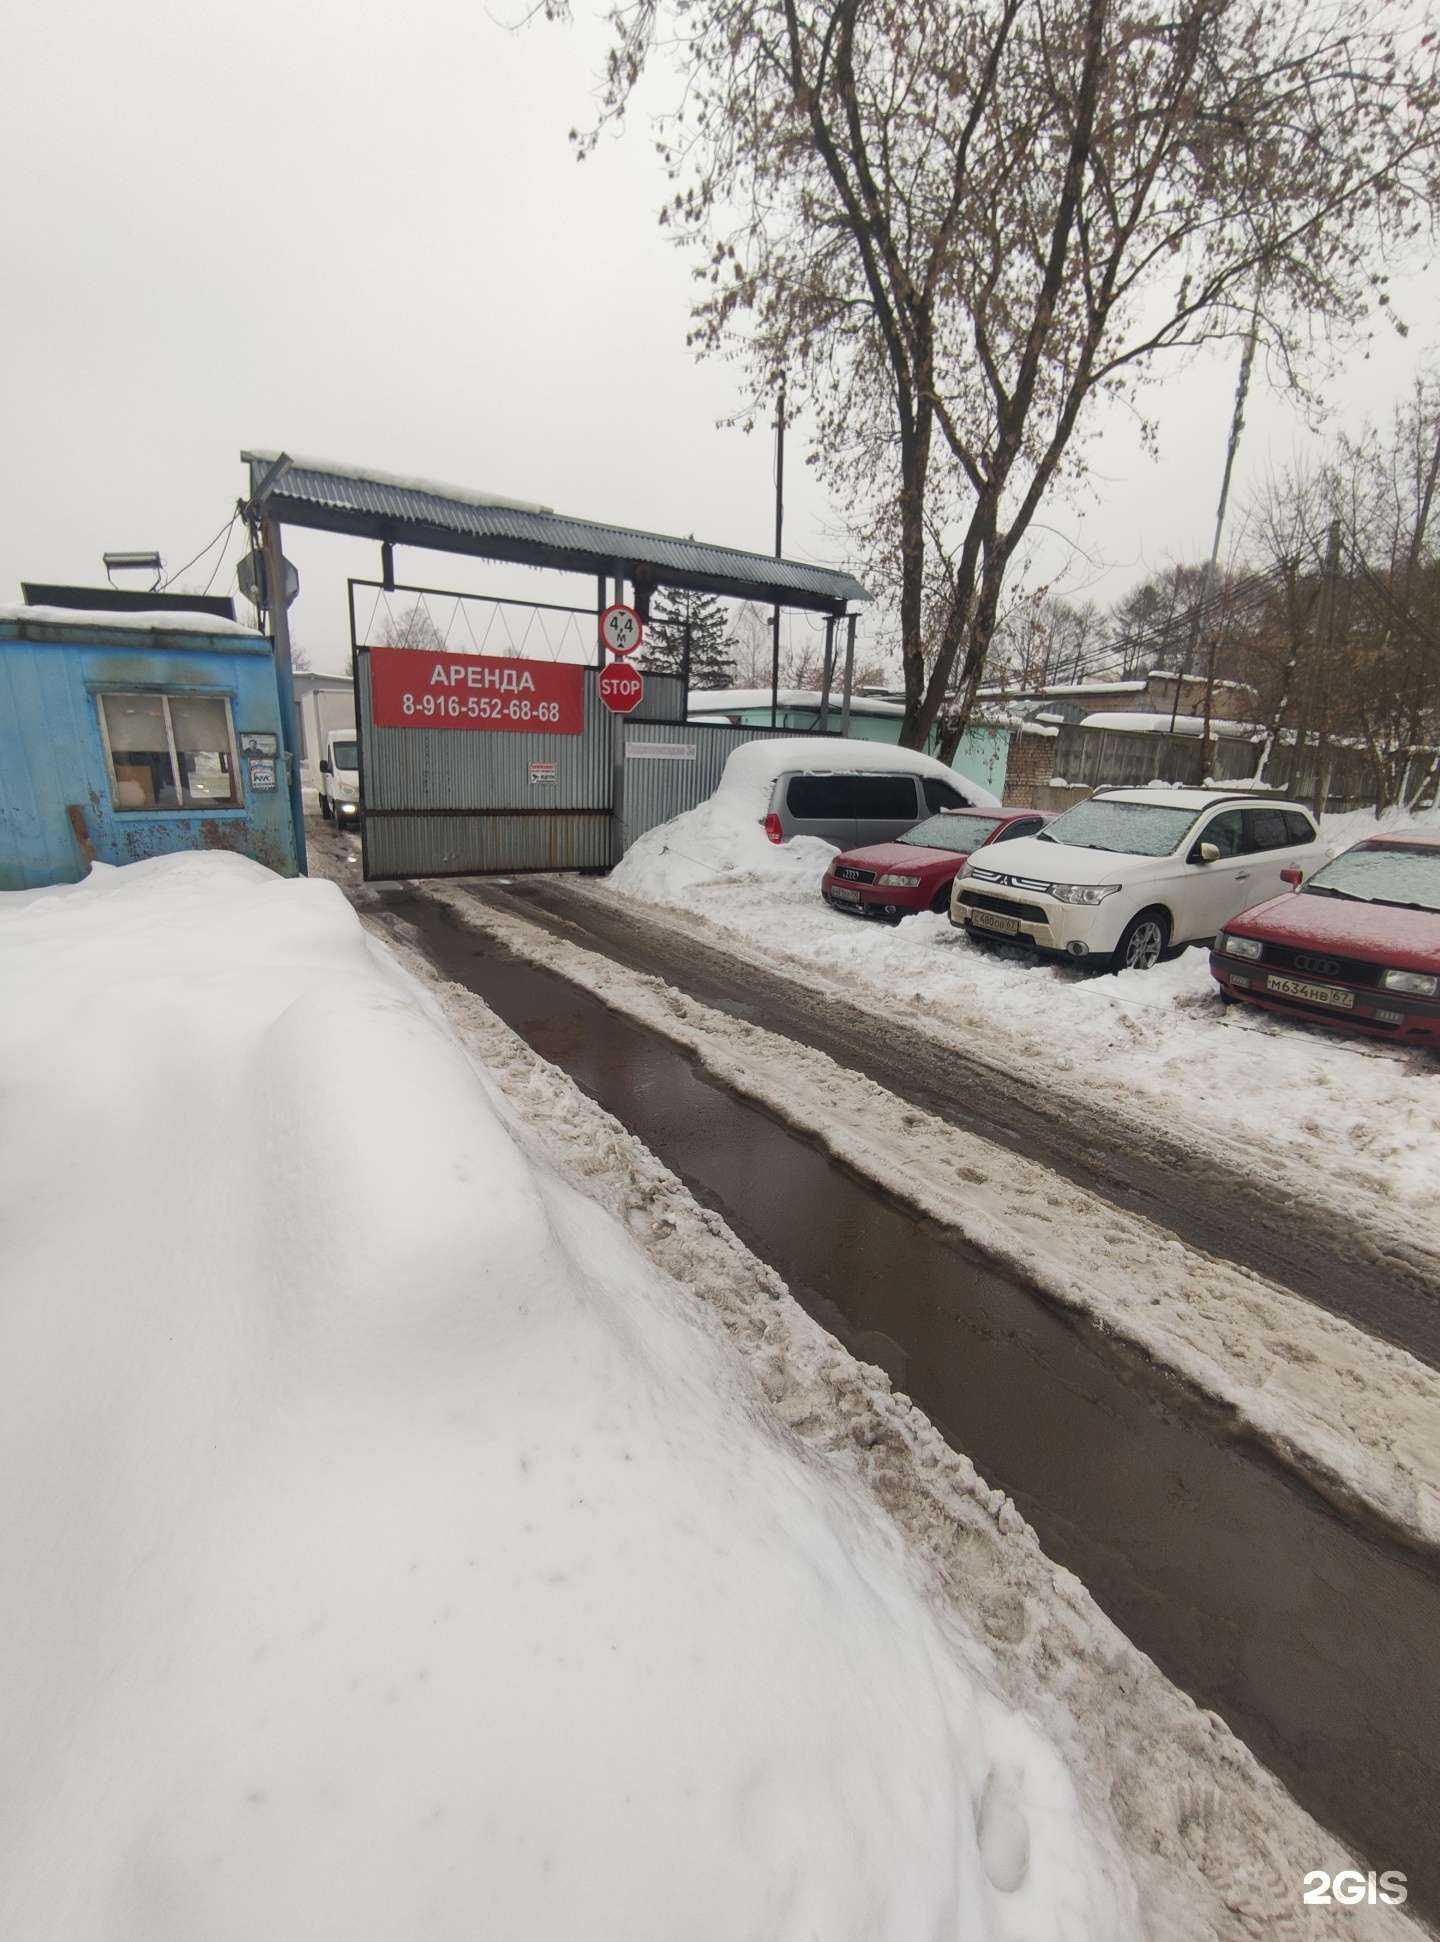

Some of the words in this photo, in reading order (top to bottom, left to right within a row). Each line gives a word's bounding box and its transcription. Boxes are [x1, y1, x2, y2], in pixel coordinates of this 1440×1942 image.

[609, 616, 634, 634] 4,4
[430, 664, 536, 694] АРЕНДА
[601, 679, 640, 696] STOP
[402, 693, 560, 723] 8-916-552-68-68
